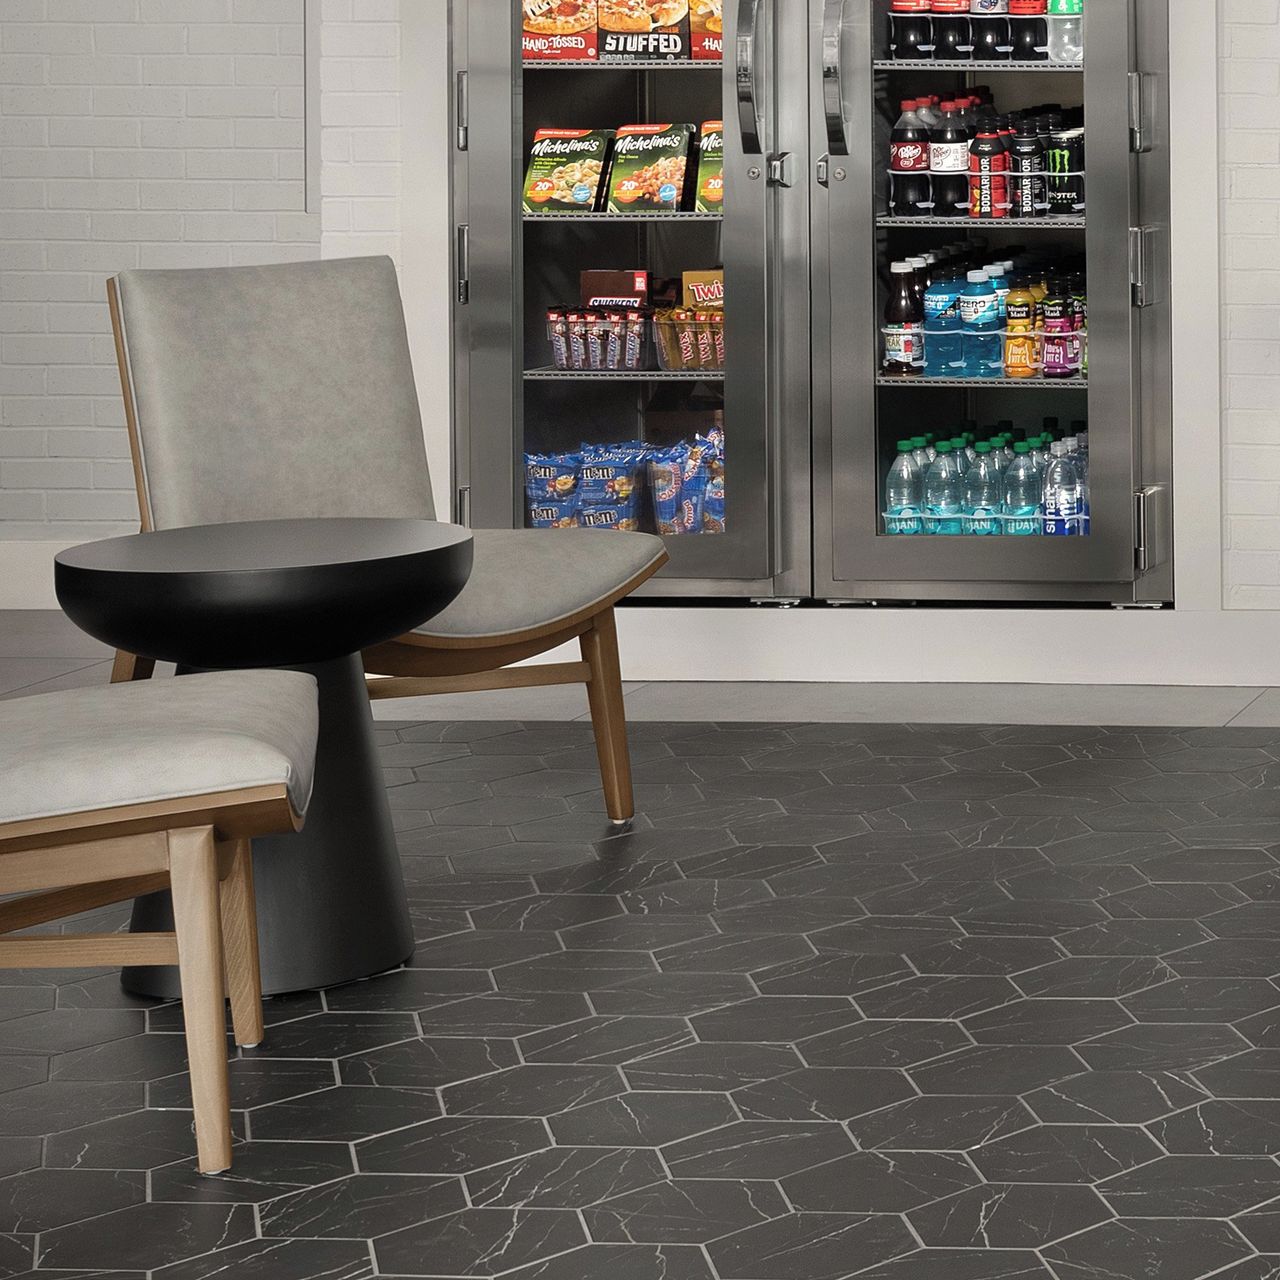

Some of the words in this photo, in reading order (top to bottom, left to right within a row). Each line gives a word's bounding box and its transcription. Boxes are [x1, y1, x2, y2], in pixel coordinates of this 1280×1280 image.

[605, 33, 683, 53] STUFFED
[531, 138, 600, 157] Michelina's
[614, 134, 681, 154] Michelina's
[1022, 158, 1032, 212] BODYAROR
